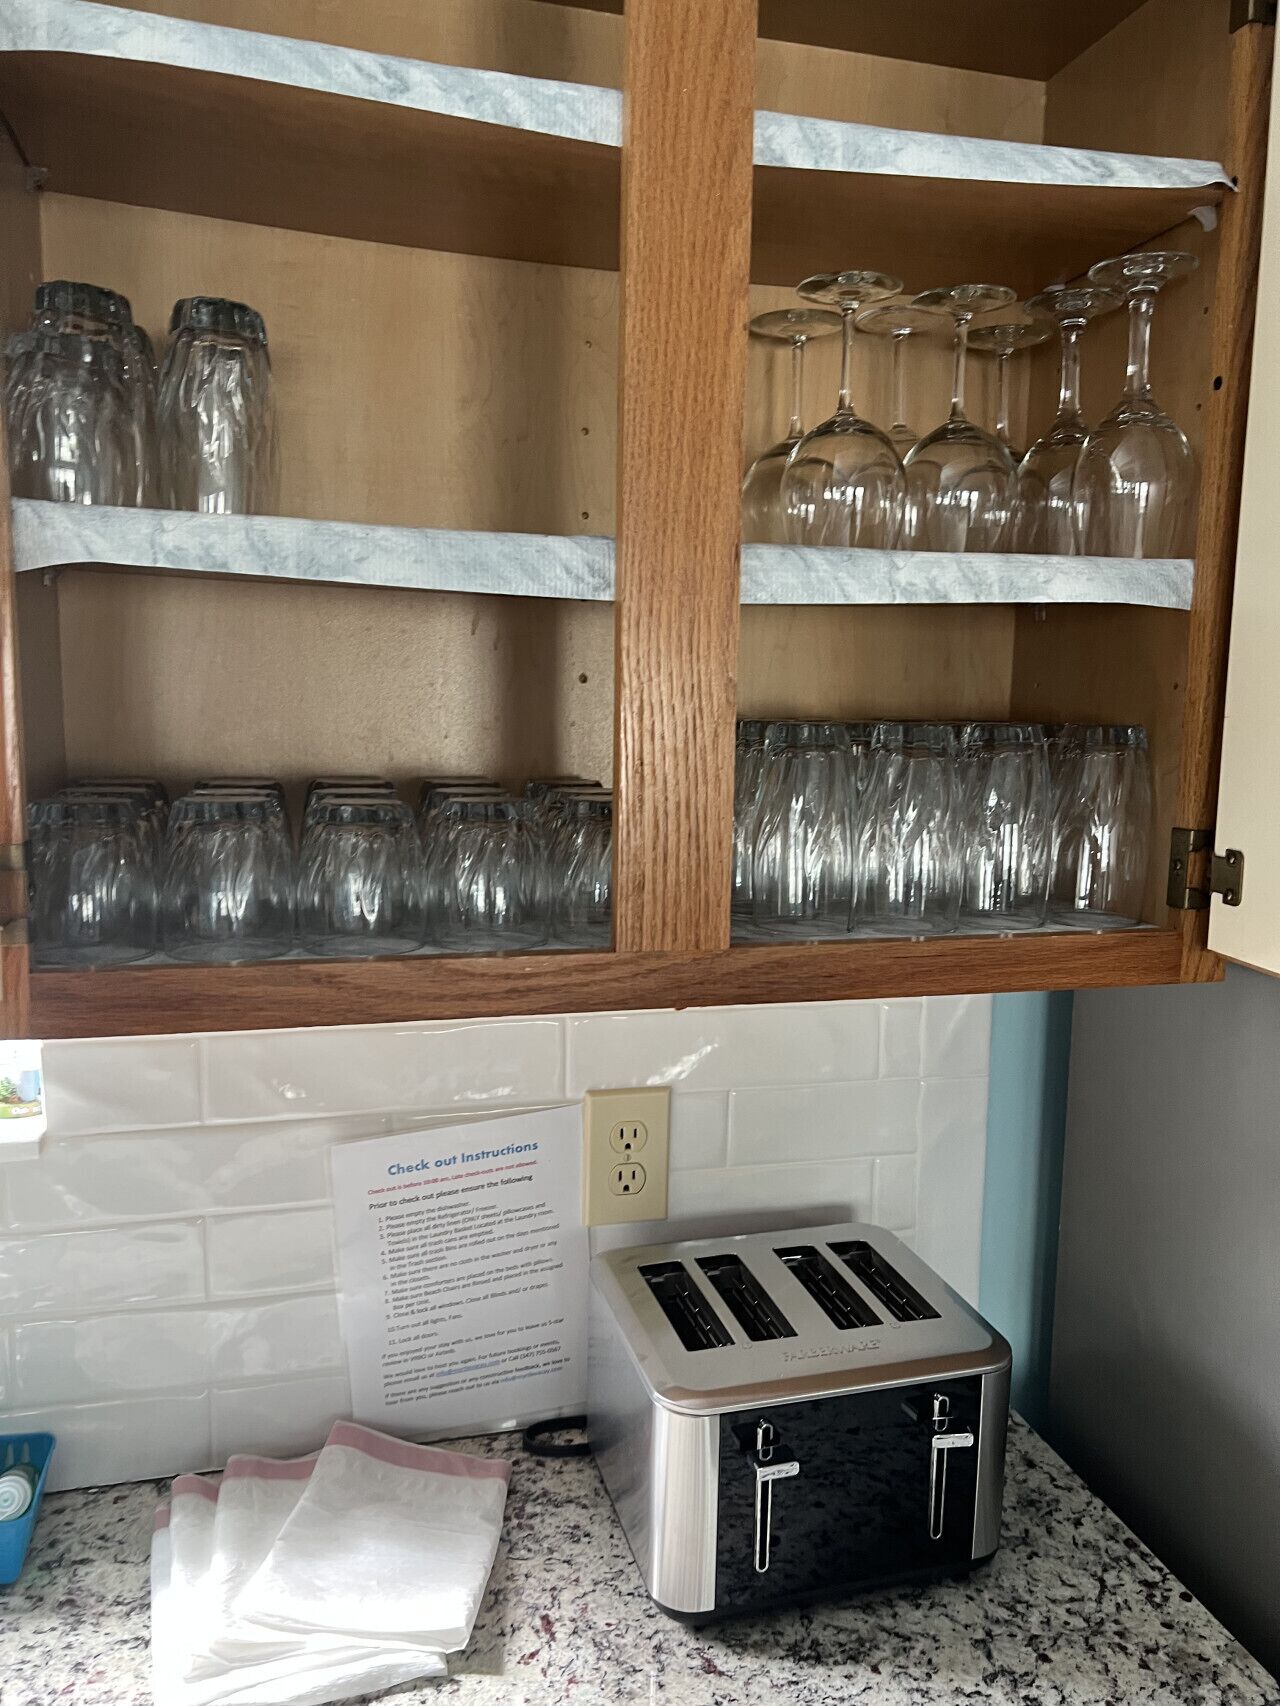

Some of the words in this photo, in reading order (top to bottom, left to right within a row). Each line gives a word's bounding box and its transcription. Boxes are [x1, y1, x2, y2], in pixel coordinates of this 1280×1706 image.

[387, 1159, 429, 1176] Check
[434, 1154, 456, 1167] out
[461, 1143, 538, 1162] Instructions
[368, 1202, 387, 1210] Prior
[399, 1194, 419, 1204] check
[421, 1192, 434, 1200] out
[435, 1189, 459, 1199] please
[461, 1184, 484, 1192] ensure
[486, 1180, 498, 1188] the
[500, 1175, 533, 1185] following
